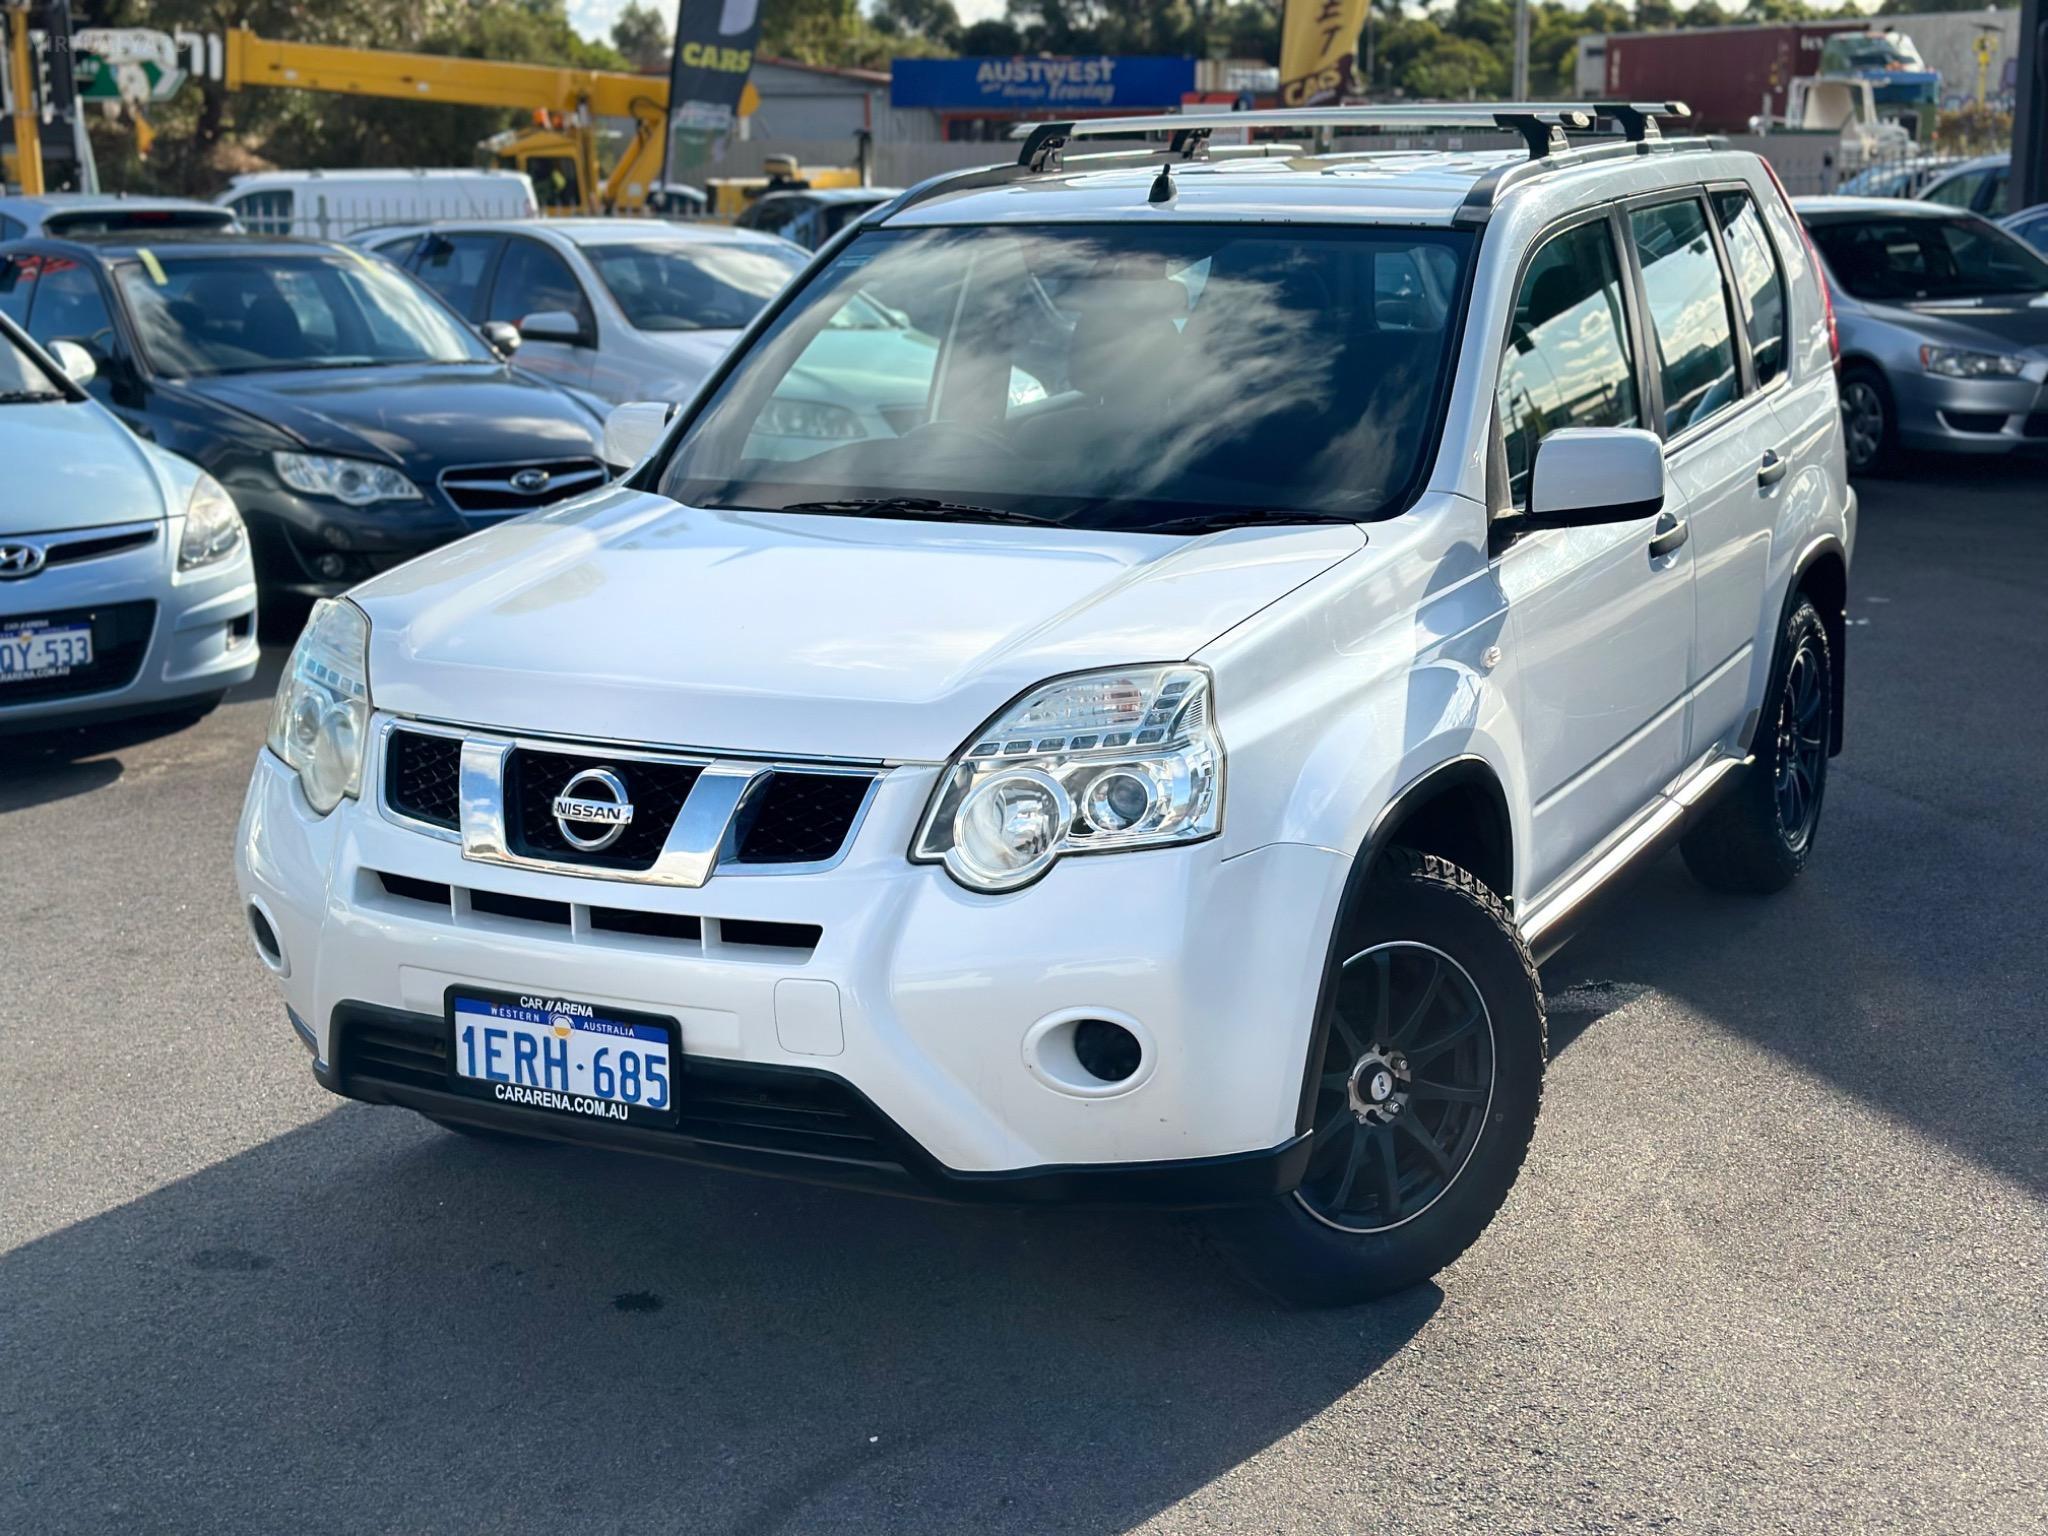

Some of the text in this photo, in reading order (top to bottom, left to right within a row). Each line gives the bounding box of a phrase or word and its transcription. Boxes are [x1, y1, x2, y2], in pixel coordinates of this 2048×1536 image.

[682, 42, 751, 73] CARS
[976, 56, 1116, 83] AUSTWEST
[556, 801, 621, 820] NISSAN
[490, 1006, 635, 1038] WESTERN AUSTRALIA
[495, 1083, 629, 1121] CARARENA.COM.AU
